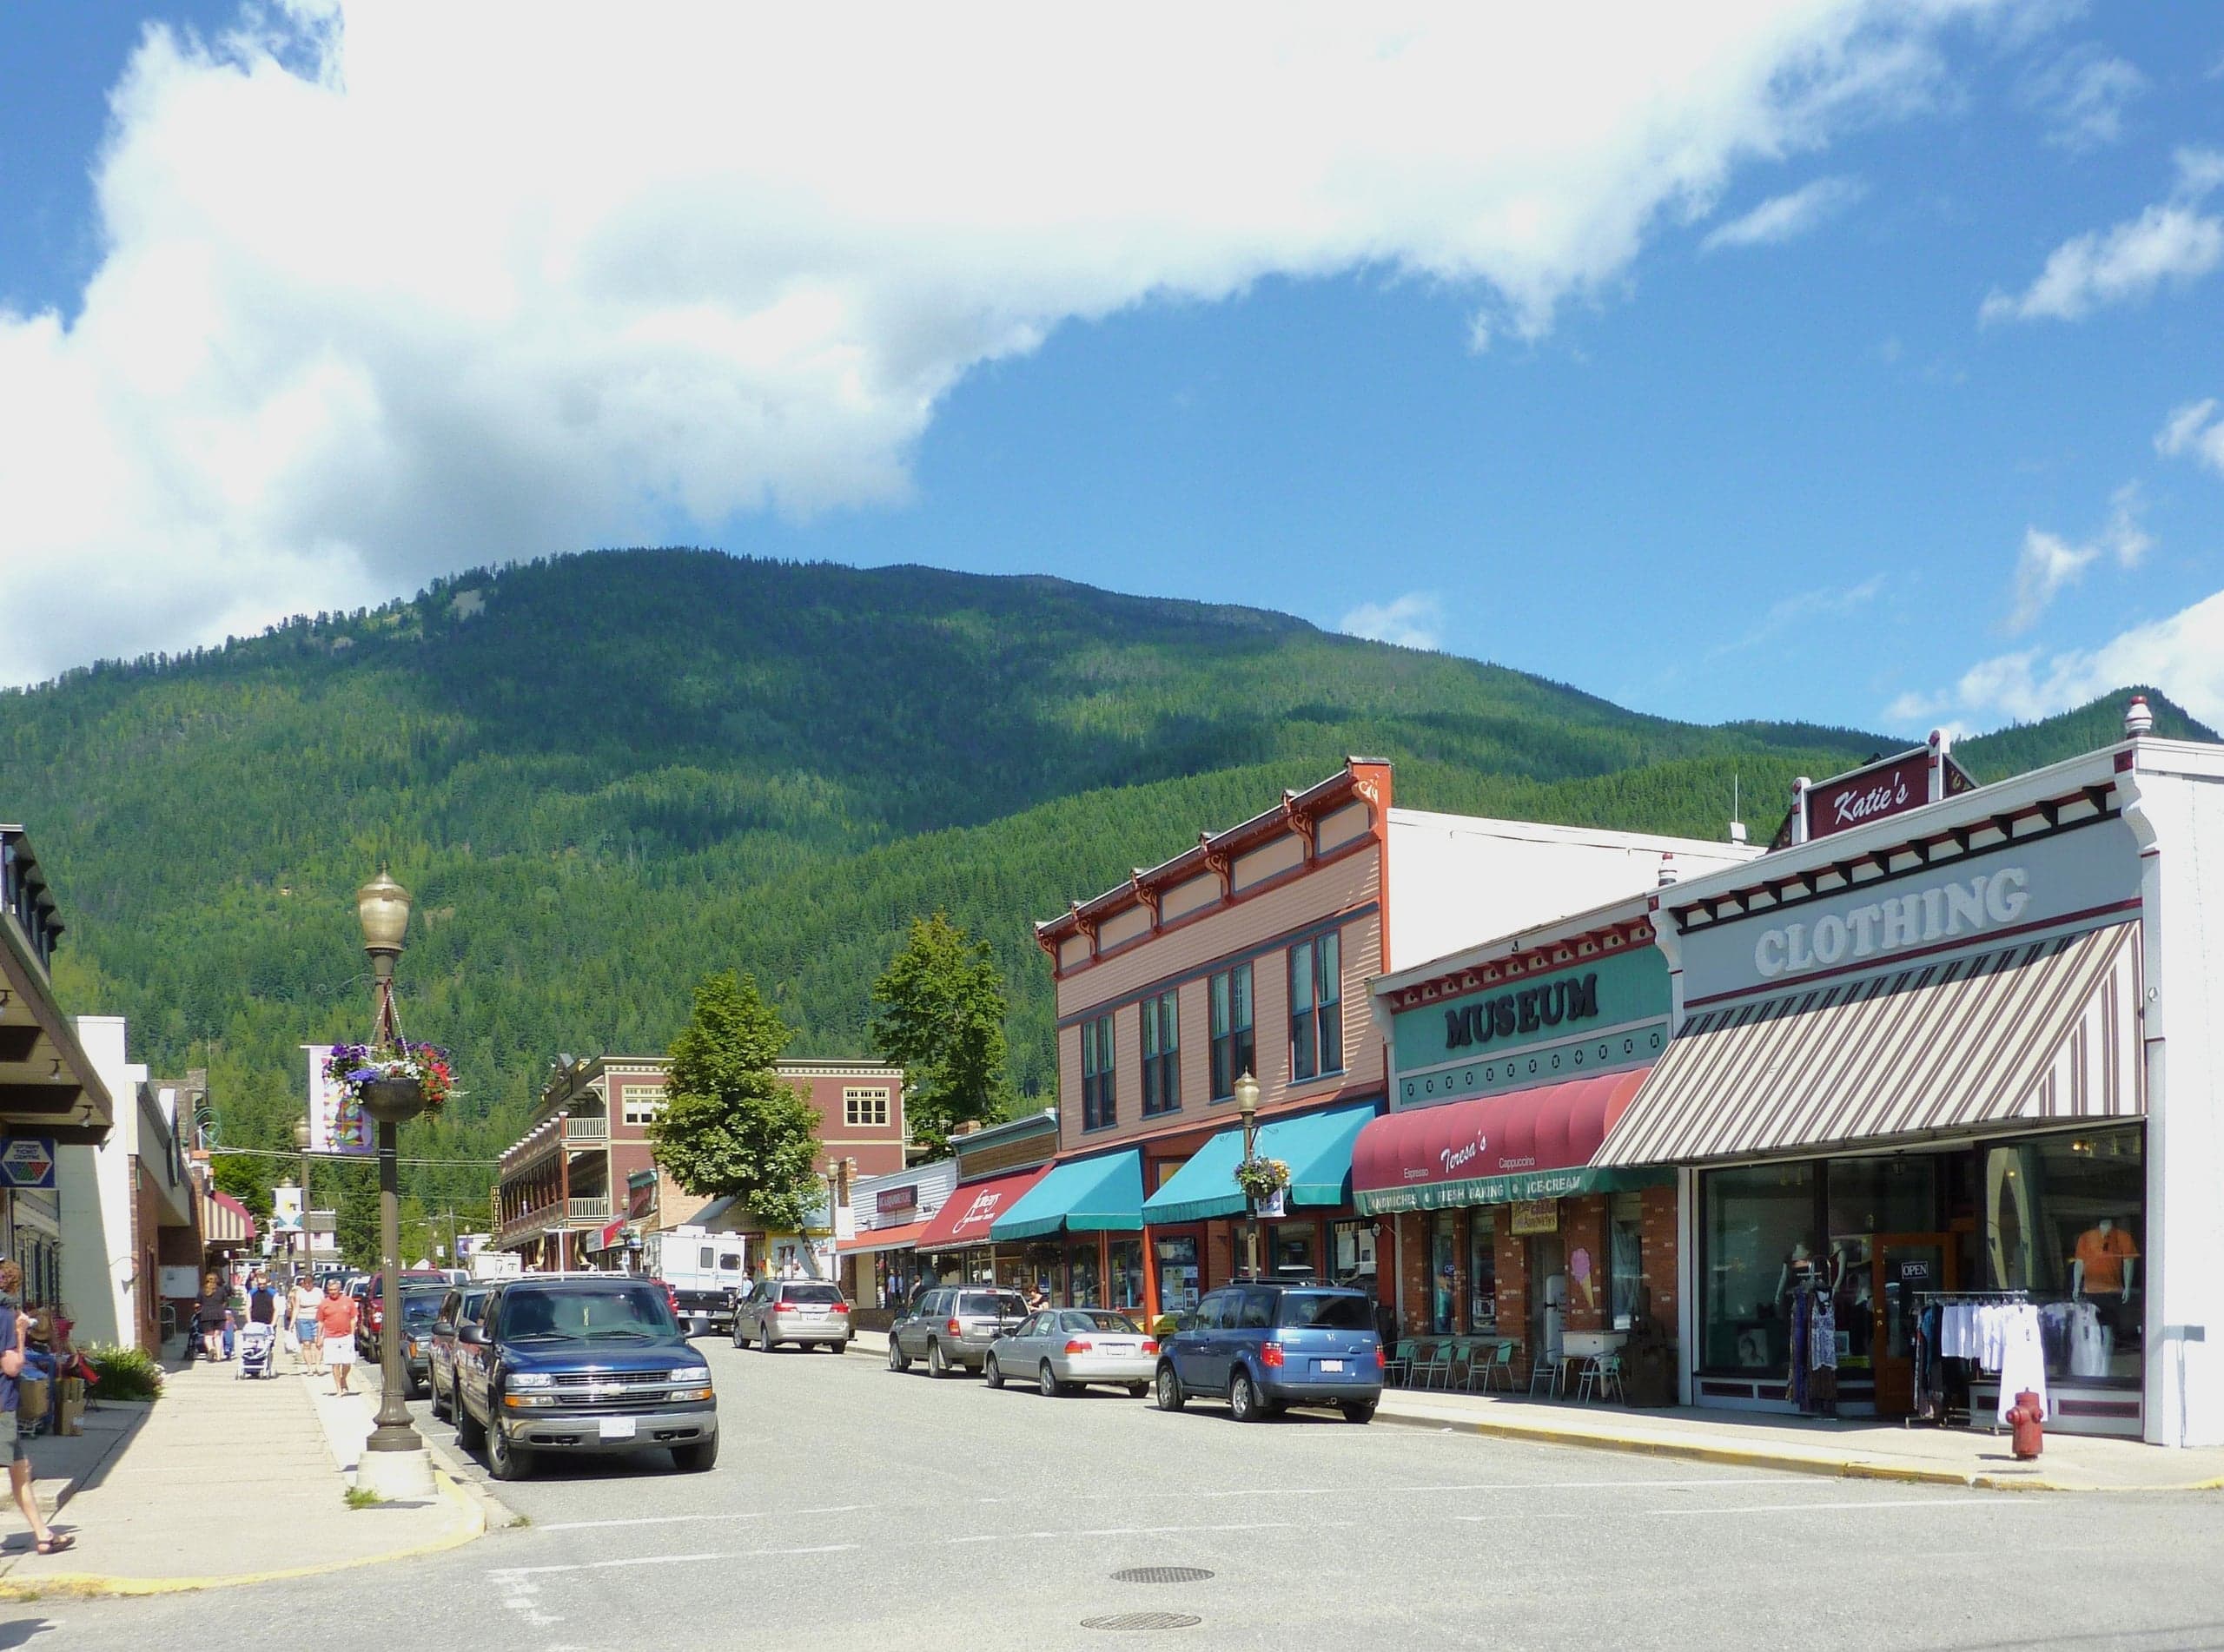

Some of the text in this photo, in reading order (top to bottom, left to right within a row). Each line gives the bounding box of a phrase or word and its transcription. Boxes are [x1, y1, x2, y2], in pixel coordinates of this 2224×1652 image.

[1833, 770, 1910, 826] Katie's
[1755, 867, 2031, 978] CLOTHING
[1444, 973, 1599, 1049] MUSEUM
[1440, 1129, 1486, 1174] Teresa's
[1498, 1155, 1536, 1171] Cappuccino
[1403, 1167, 1430, 1181] Espresso
[1438, 1188, 1466, 1203] FRESH
[1469, 1184, 1505, 1199] BAKING
[1527, 1175, 1581, 1194] ICE-CREAM
[1903, 1265, 1927, 1276] OPEN
